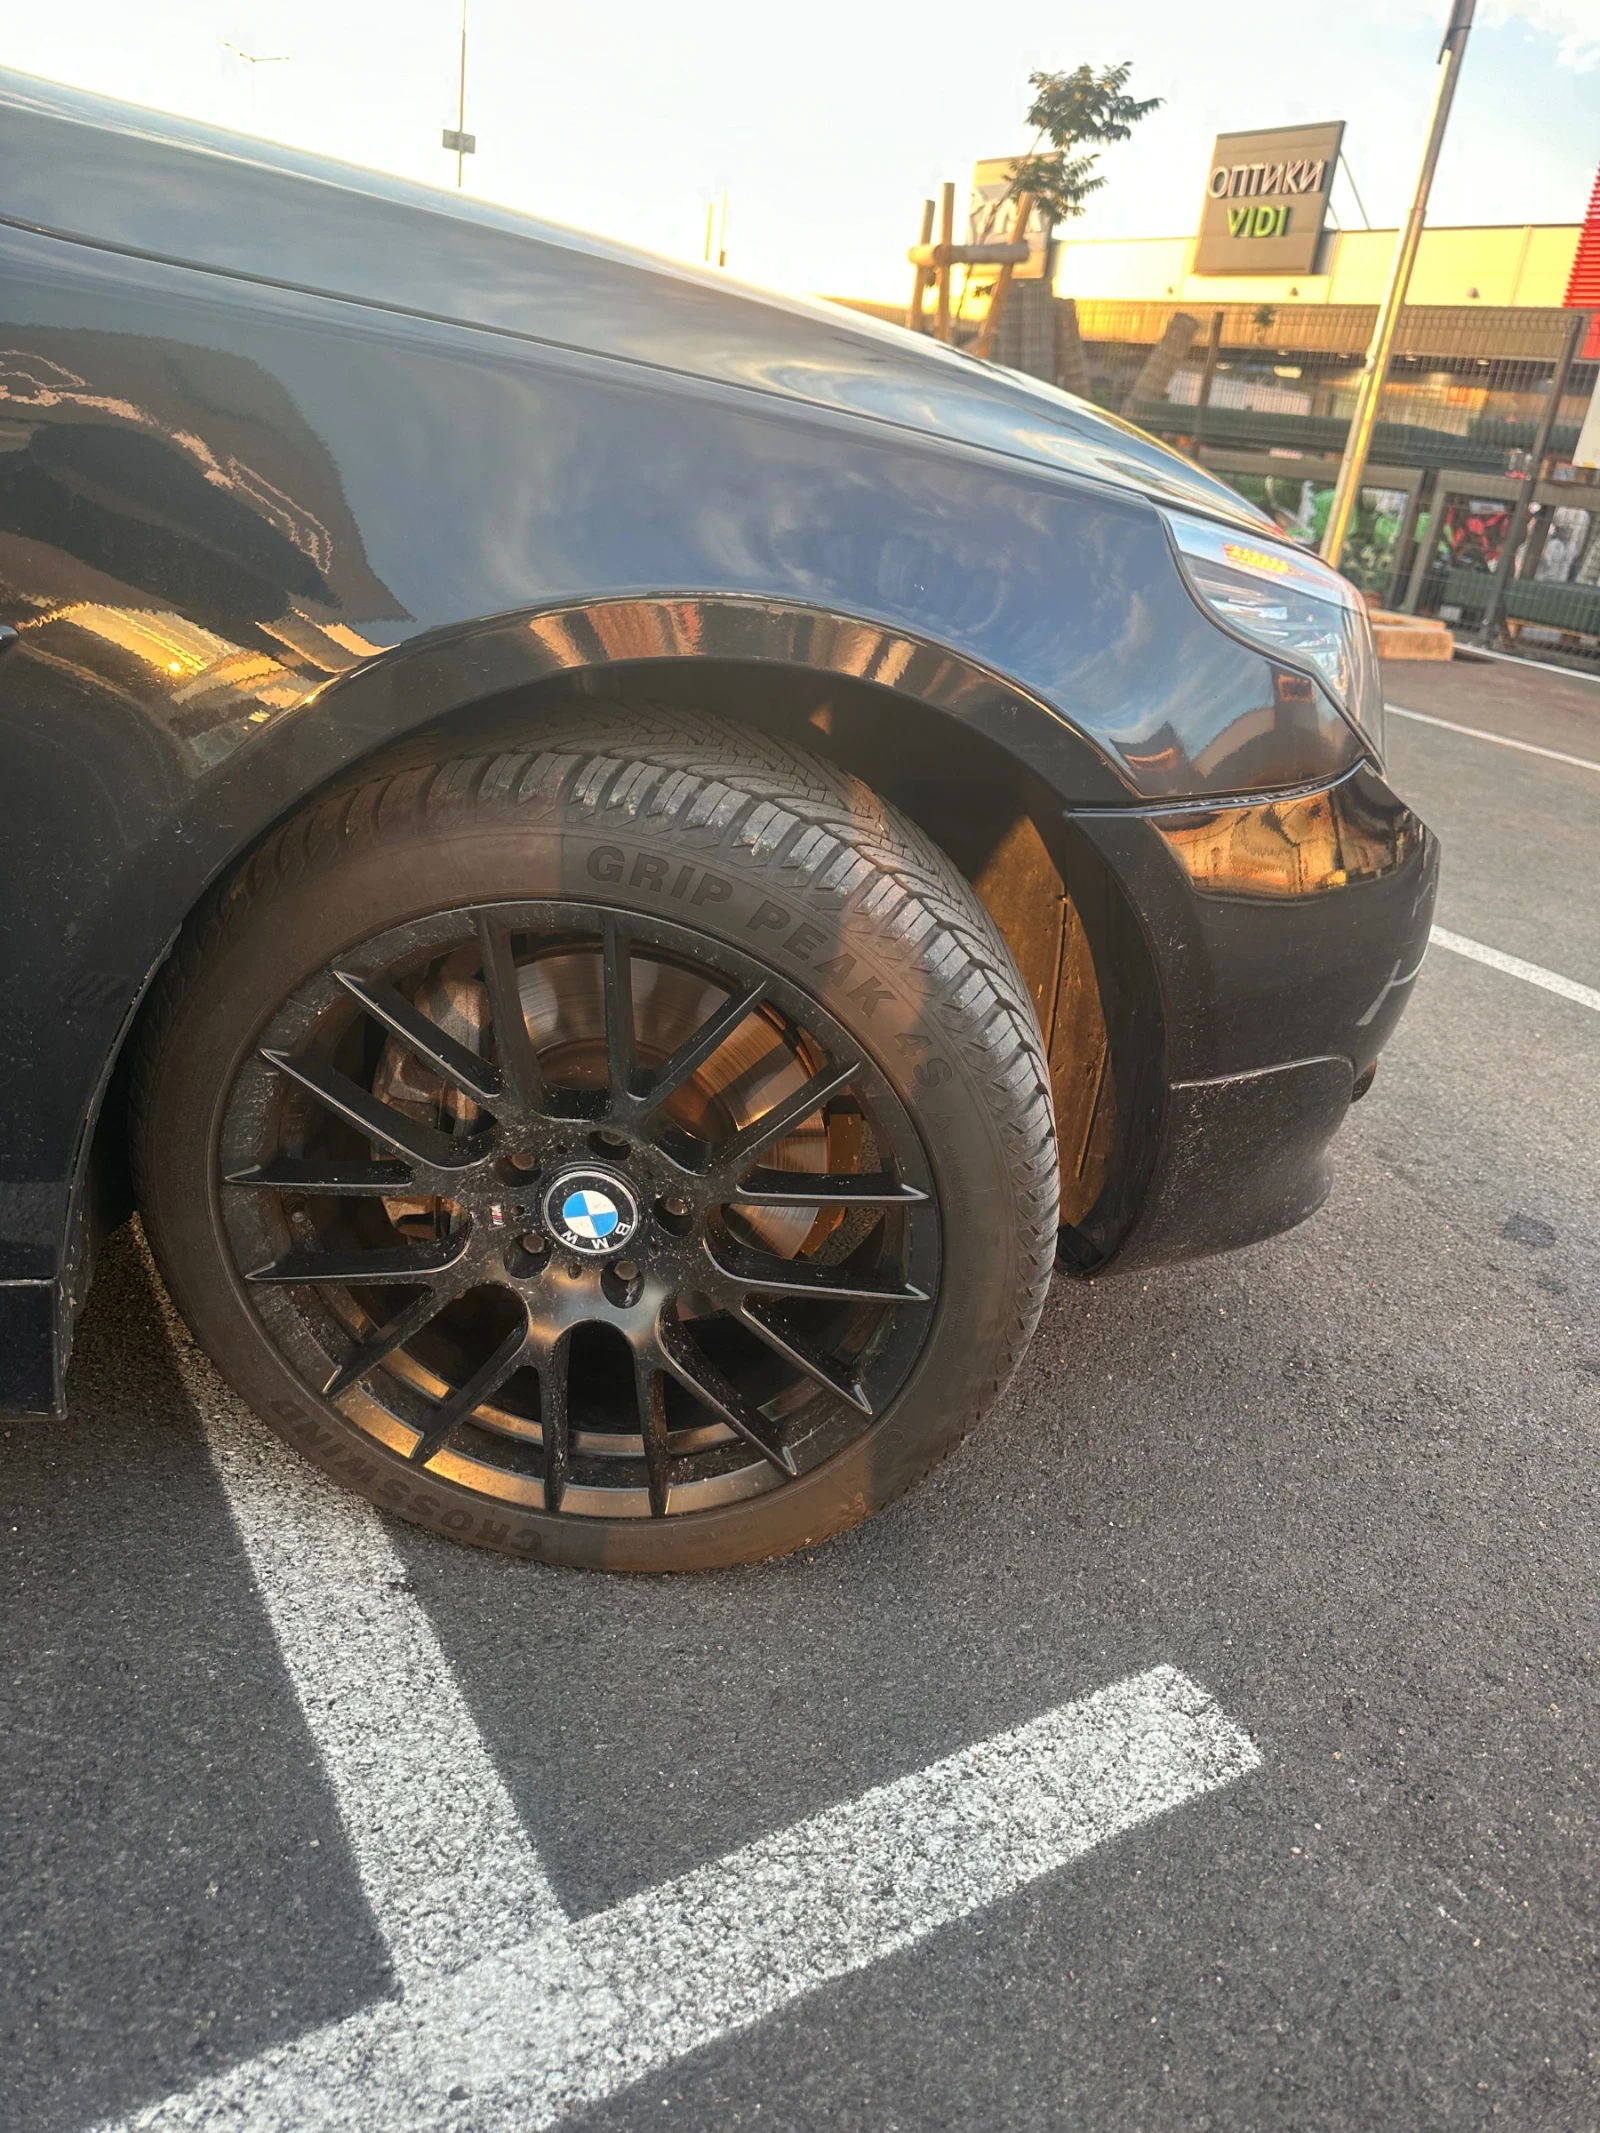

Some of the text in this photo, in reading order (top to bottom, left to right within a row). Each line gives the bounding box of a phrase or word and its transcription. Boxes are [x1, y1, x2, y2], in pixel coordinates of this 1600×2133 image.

[1208, 159, 1326, 198] ОПТИКИ
[1227, 204, 1289, 237] VIDI
[586, 845, 953, 1088] GRIP PEAK 4S
[561, 1221, 632, 1250] BMW
[269, 1399, 542, 1553] CROSSWIND
